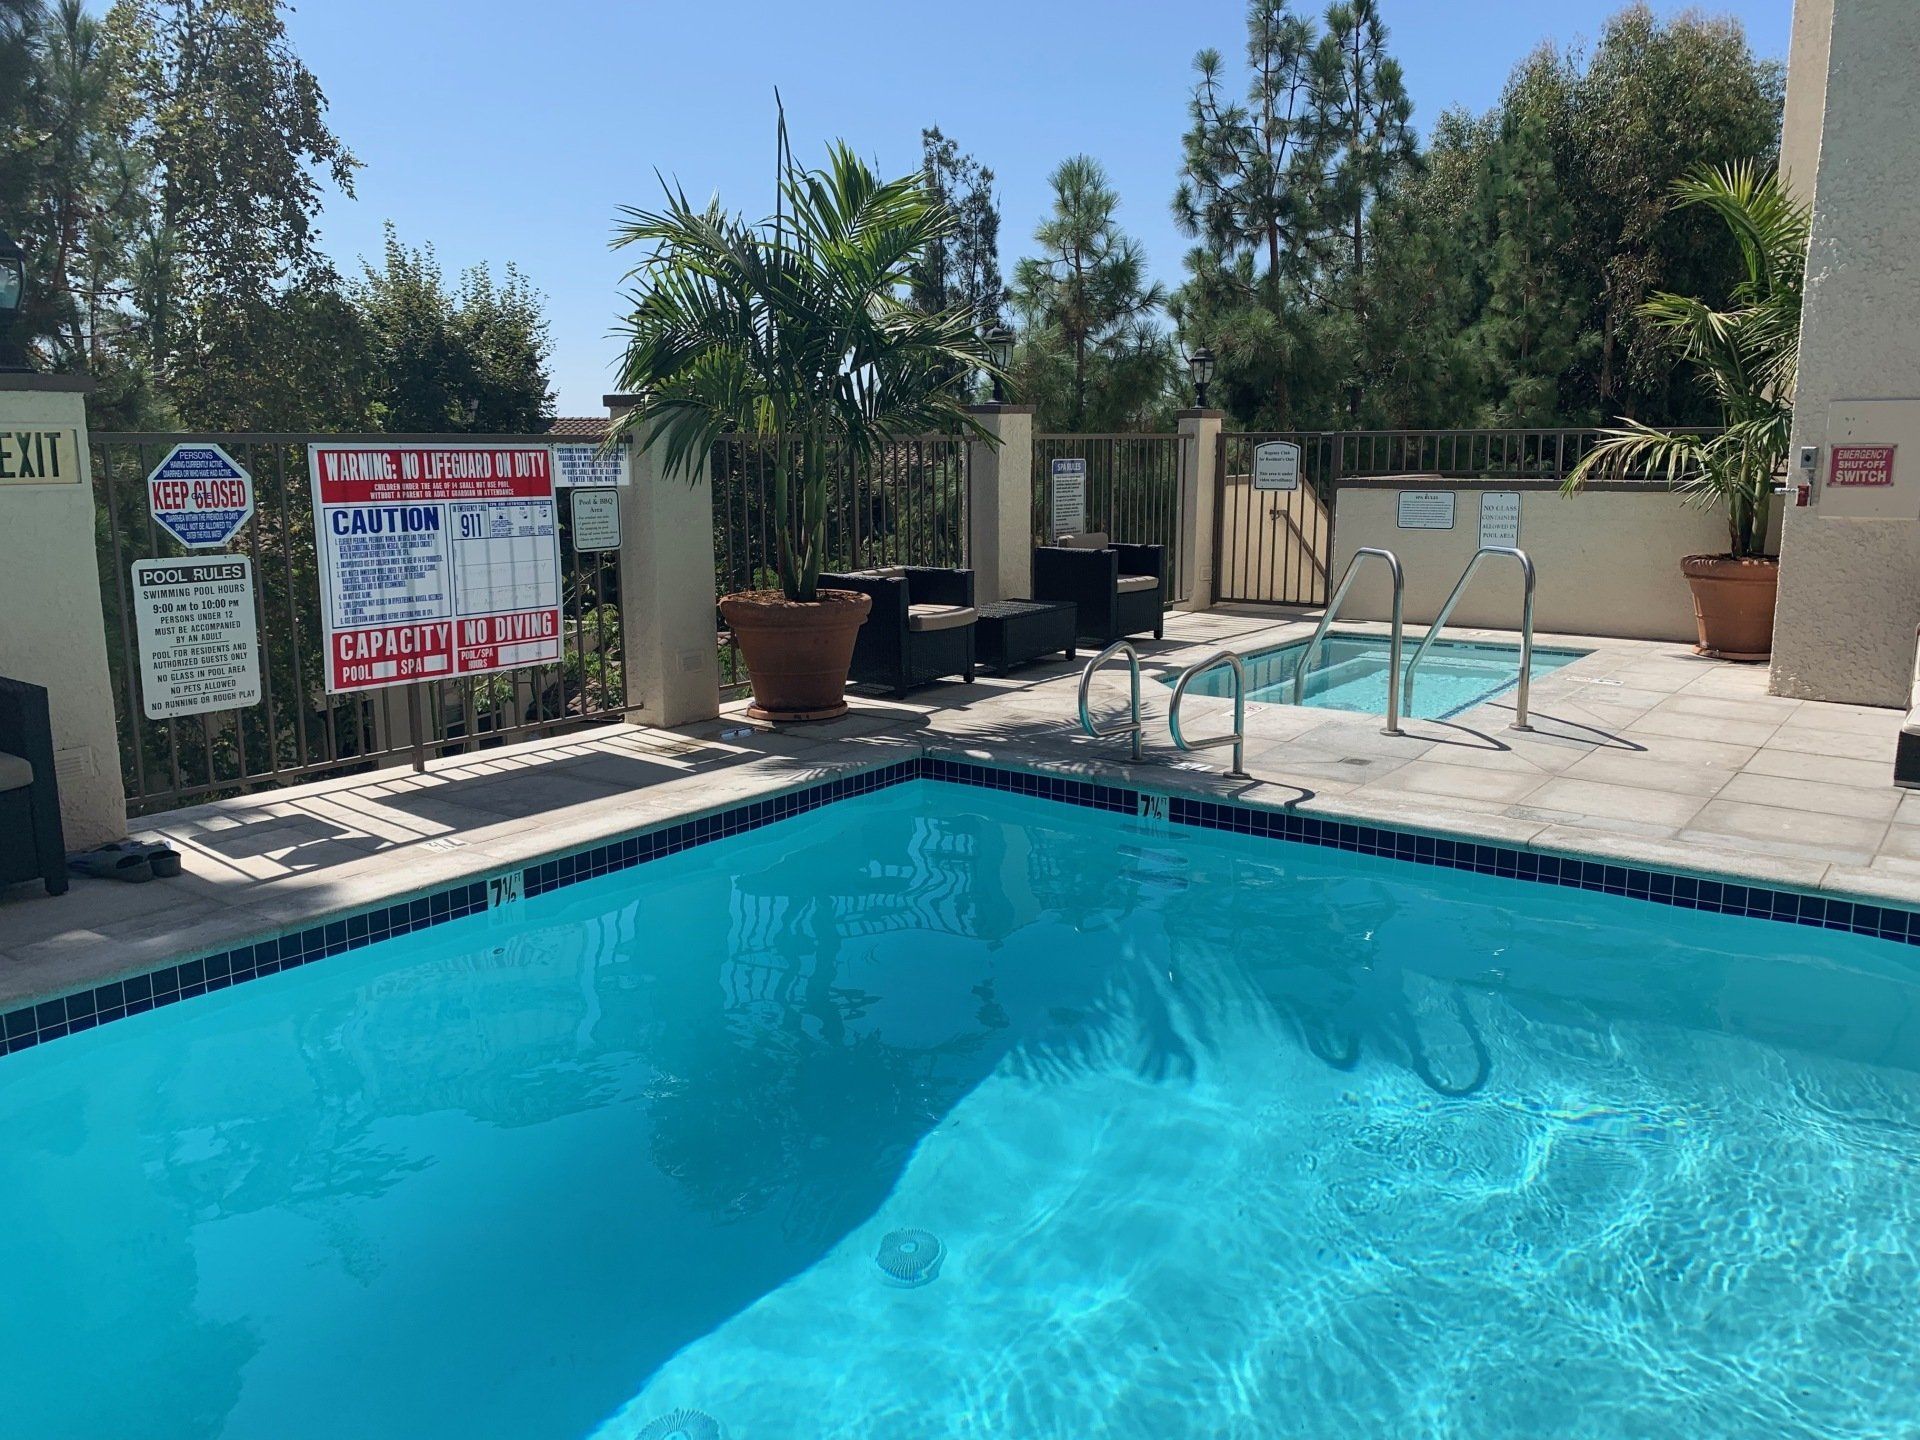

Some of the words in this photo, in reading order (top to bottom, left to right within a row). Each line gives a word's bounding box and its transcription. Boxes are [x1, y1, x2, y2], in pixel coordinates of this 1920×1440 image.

[0, 431, 61, 478] EXIT
[180, 451, 213, 460] PERSONS
[1838, 450, 1889, 459] EMERGENCY
[185, 460, 209, 468] CURRENTLY
[209, 460, 223, 468] ACTIVE
[324, 453, 397, 481] WARNING:
[400, 453, 420, 479] NO
[423, 452, 492, 479] LIFEGUARD
[495, 452, 512, 478] ON
[514, 452, 544, 478] DUTY
[1057, 463, 1067, 472] SPA
[1067, 463, 1081, 471] RULES
[1838, 461, 1886, 469] SHUT-OFF
[163, 470, 183, 478] DIARRHEA
[210, 469, 218, 477] HAD
[218, 469, 231, 477] ACTIVE
[1835, 470, 1887, 482] SWITCH
[374, 483, 401, 491] CHILDREN
[432, 482, 443, 490] AGE
[459, 481, 475, 489] SHALL
[152, 481, 189, 510] KEEP
[194, 480, 246, 509] CLOSED
[191, 492, 212, 500] GATE
[370, 492, 395, 500] WITHOUT
[396, 491, 400, 499] A
[402, 491, 423, 499] PARENT
[433, 490, 449, 498] ADULT
[451, 489, 476, 497] GUARDIAN
[600, 497, 613, 505] BBQ
[165, 515, 186, 523] DIARRHEA
[185, 514, 199, 522] WITHIN
[205, 513, 224, 521] PREVIOUS
[228, 512, 238, 520] DAYS
[332, 507, 439, 536] CAUTION
[175, 523, 189, 531] SHALL
[199, 522, 205, 530] BE
[225, 521, 232, 529] TO
[461, 513, 481, 537] 911
[211, 530, 222, 538] WATER
[143, 570, 187, 584] POOL
[193, 565, 242, 580] RULES
[143, 588, 190, 600] SWIMMING
[194, 586, 215, 596] POOL
[218, 584, 245, 594] HOURS
[153, 604, 173, 614] 9:00
[189, 602, 198, 610] to
[202, 599, 226, 609] 10:00
[160, 614, 194, 624] PERSONS
[197, 612, 221, 621] UNDER
[155, 627, 175, 636] MUST
[191, 621, 241, 632] ACCOMPANIED
[464, 619, 487, 645] NO
[495, 612, 552, 642] DIVING
[176, 636, 184, 644] BY
[201, 632, 222, 641] ADULT
[340, 623, 449, 660] CAPACITY
[152, 651, 171, 660] POOL
[191, 645, 230, 656] RESIDENTS
[461, 650, 493, 661] POOL/SPA
[153, 658, 198, 670] AUTHORIZED
[201, 654, 228, 664] GUESTS
[231, 652, 248, 660] ONLY
[468, 658, 488, 668] HOURS
[157, 675, 167, 683] NO
[171, 671, 194, 681] GLASS
[208, 667, 226, 676] POOL
[228, 665, 246, 674] AREA
[343, 666, 372, 683] POOL
[401, 659, 422, 675] SPA
[171, 687, 180, 695] NO
[184, 684, 201, 693] PETS
[204, 680, 236, 690] ALLOWED
[165, 698, 198, 709] RUNNING
[201, 696, 211, 704] OR
[214, 693, 236, 702] ROUGH
[239, 690, 255, 698] PLAY
